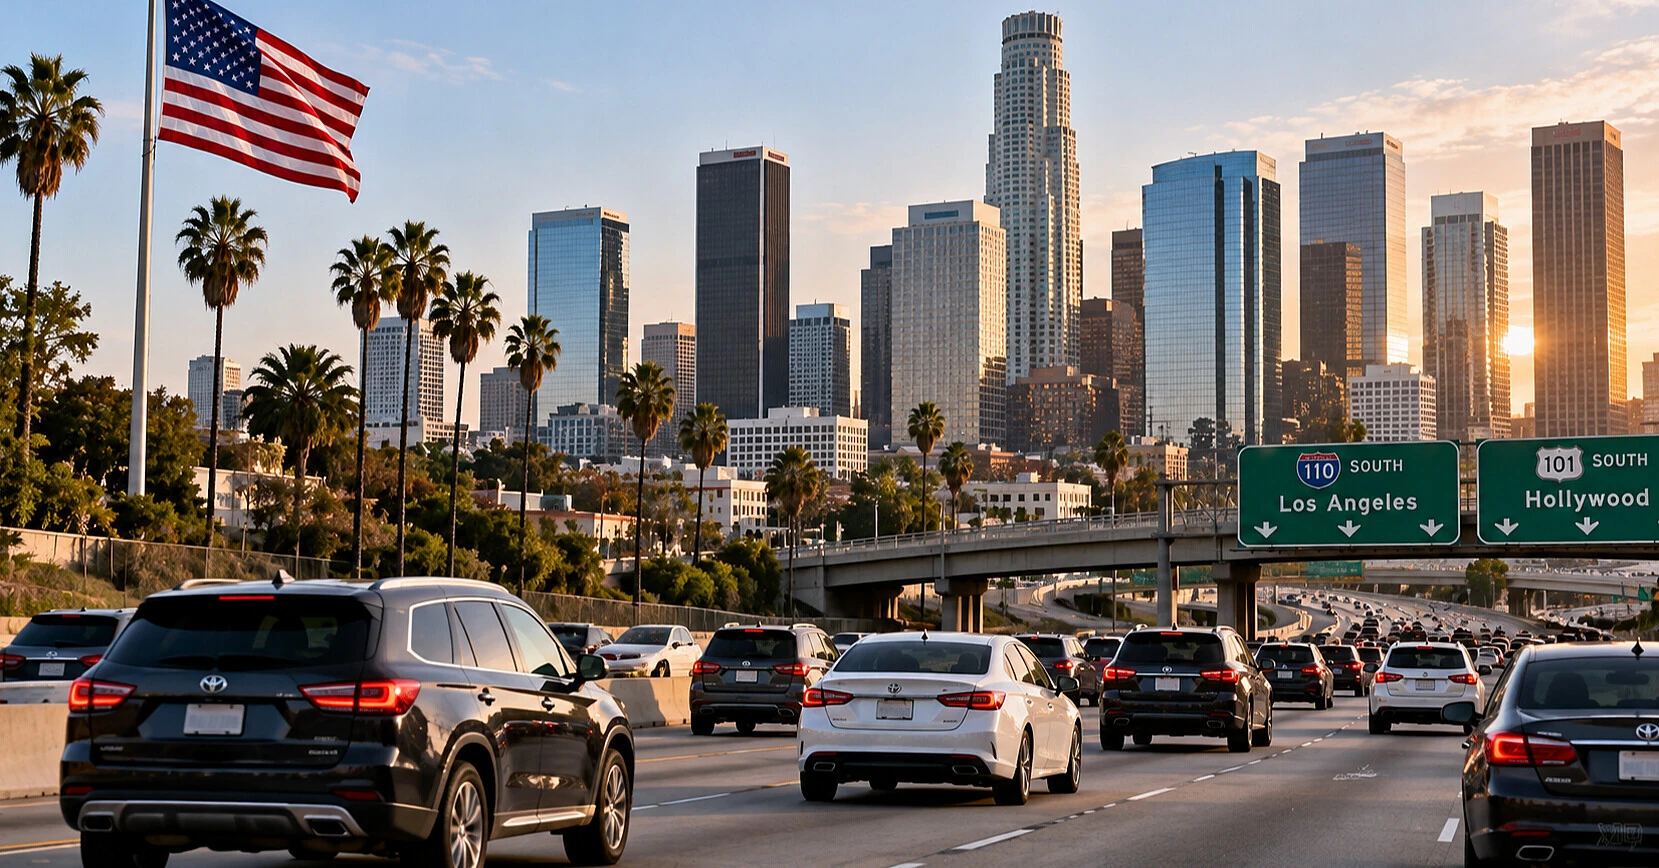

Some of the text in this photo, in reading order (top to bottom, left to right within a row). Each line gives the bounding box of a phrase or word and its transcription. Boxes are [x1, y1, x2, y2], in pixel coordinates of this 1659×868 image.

[1304, 459, 1403, 480] 110 SOUTH
[1544, 453, 1648, 472] 101 SOUTH
[1279, 492, 1418, 516] Los Angeles
[1525, 487, 1650, 513] Hollywood
